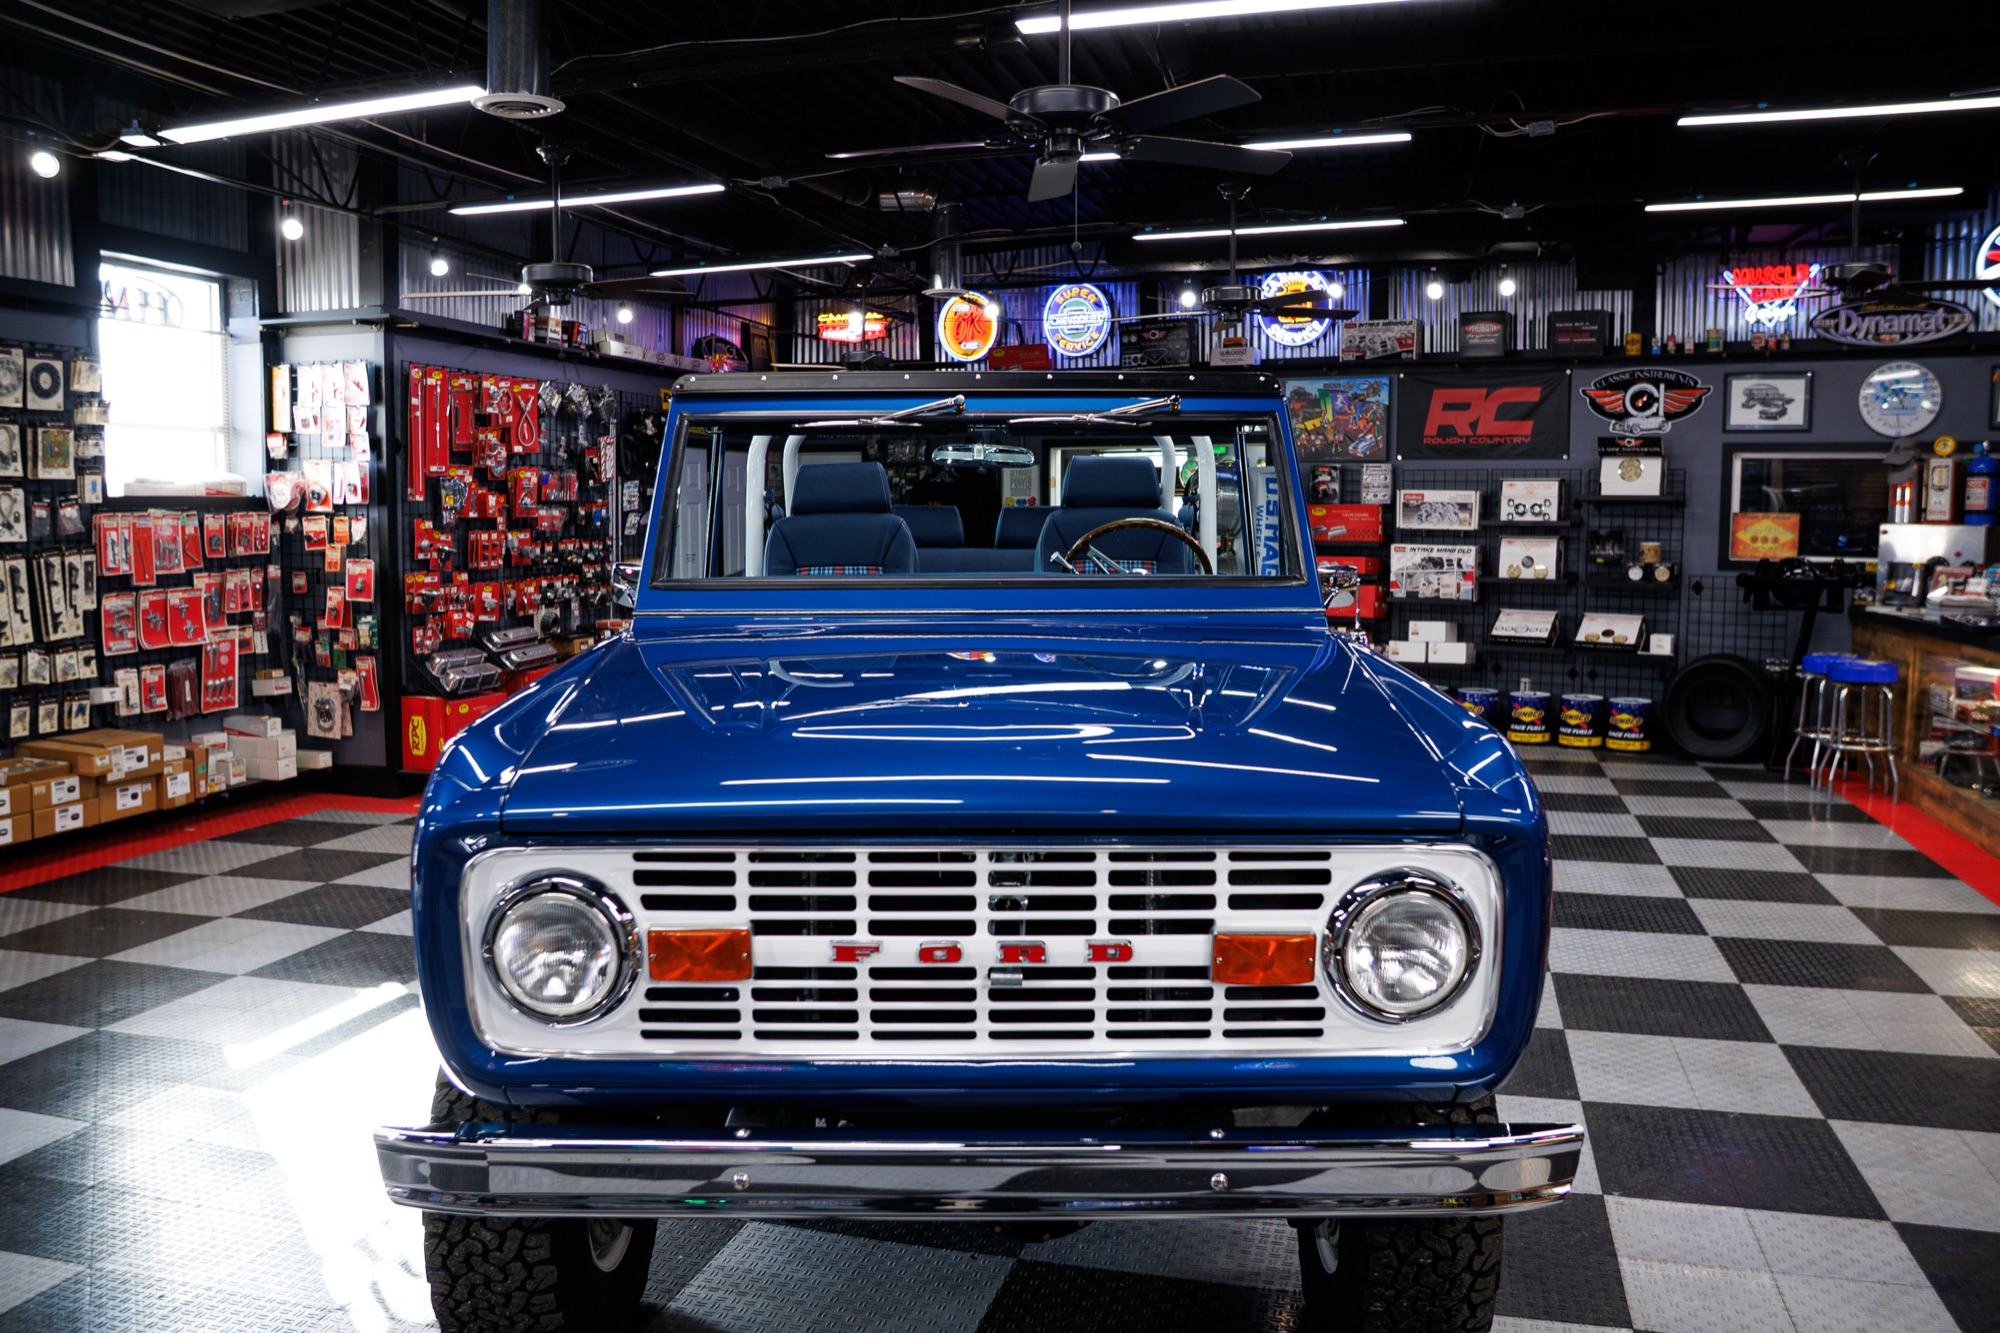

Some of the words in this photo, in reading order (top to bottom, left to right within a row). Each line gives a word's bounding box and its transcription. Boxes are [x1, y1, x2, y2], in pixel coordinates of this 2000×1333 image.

[1732, 264, 1810, 286] MUSCLE
[1056, 287, 1097, 304] SUPER
[1268, 320, 1322, 343] SERVICE
[1838, 307, 1945, 339] Dynamat
[1054, 332, 1099, 350] SERVICE
[1595, 373, 1634, 389] CLASSIC
[1635, 370, 1695, 387] INSTRUMENTS
[1423, 386, 1542, 436] RC
[1423, 437, 1465, 445] ROUGH
[1469, 436, 1531, 444] COUNTRY
[1010, 478, 1032, 489] POWER
[1256, 505, 1264, 558] WHEELS
[1511, 709, 1545, 719] SUNOCO
[1560, 711, 1592, 722] SUNOCO
[1609, 715, 1643, 726] SUNOCO
[411, 718, 420, 752] RPC
[829, 939, 1133, 964] FORD
